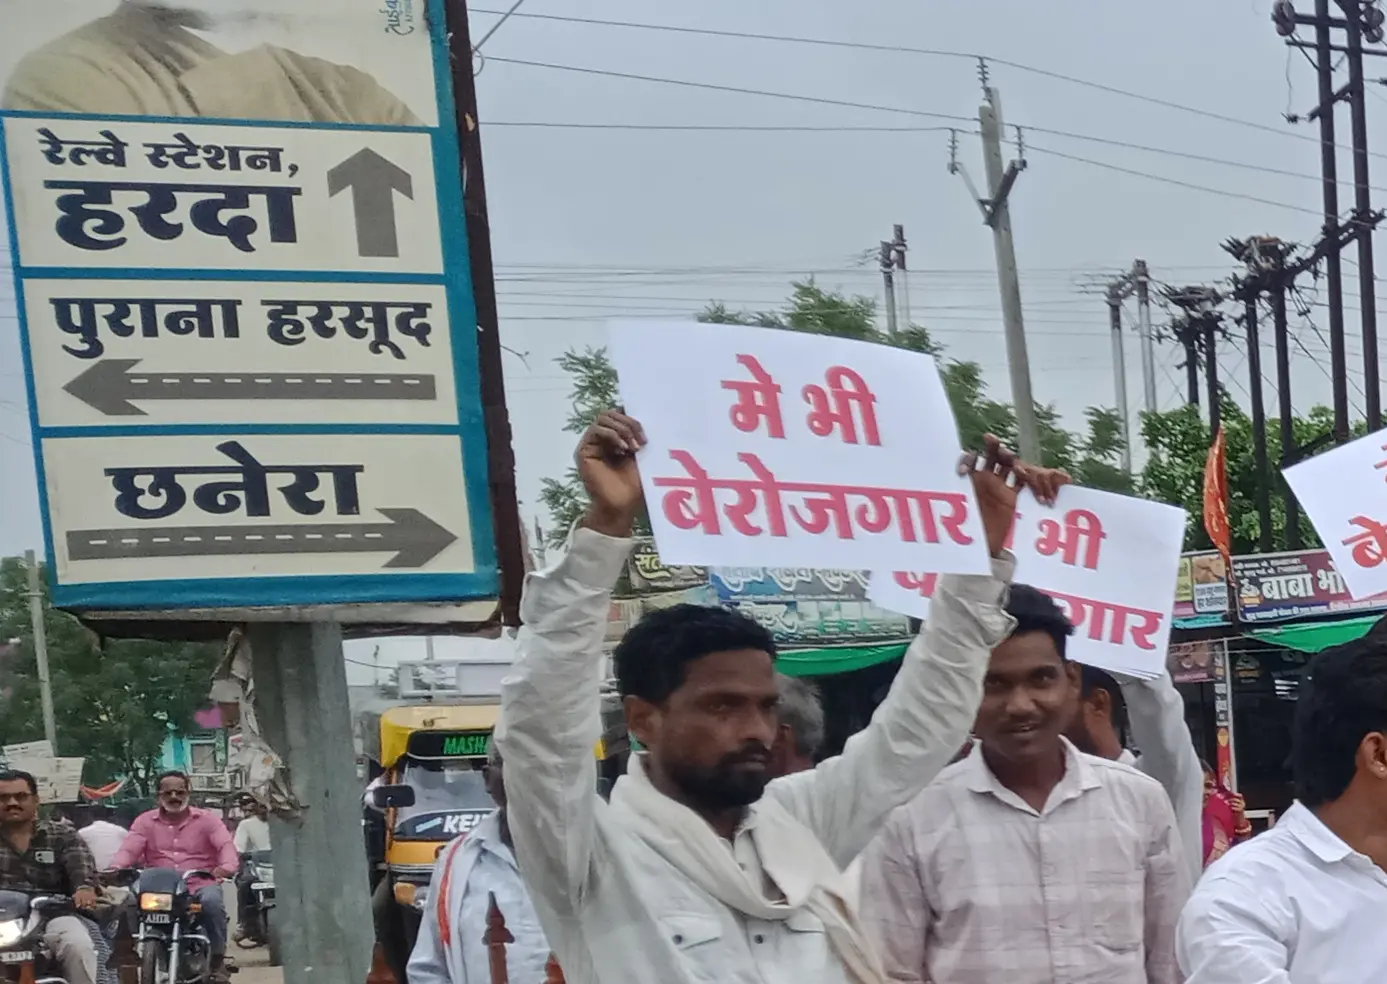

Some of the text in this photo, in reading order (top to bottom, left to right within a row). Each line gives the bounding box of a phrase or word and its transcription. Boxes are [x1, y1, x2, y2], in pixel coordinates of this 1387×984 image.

[37, 127, 300, 177] रेल्वे स्टेशन,
[44, 180, 302, 253] हरदा
[49, 298, 433, 360] पुराना हरसूद
[801, 365, 883, 447] भी
[103, 441, 365, 520] छनेरा
[653, 449, 974, 546] बेरोजगार
[1033, 508, 1107, 571] भी
[1258, 573, 1316, 601] बाबा
[145, 913, 171, 924] AHIR
